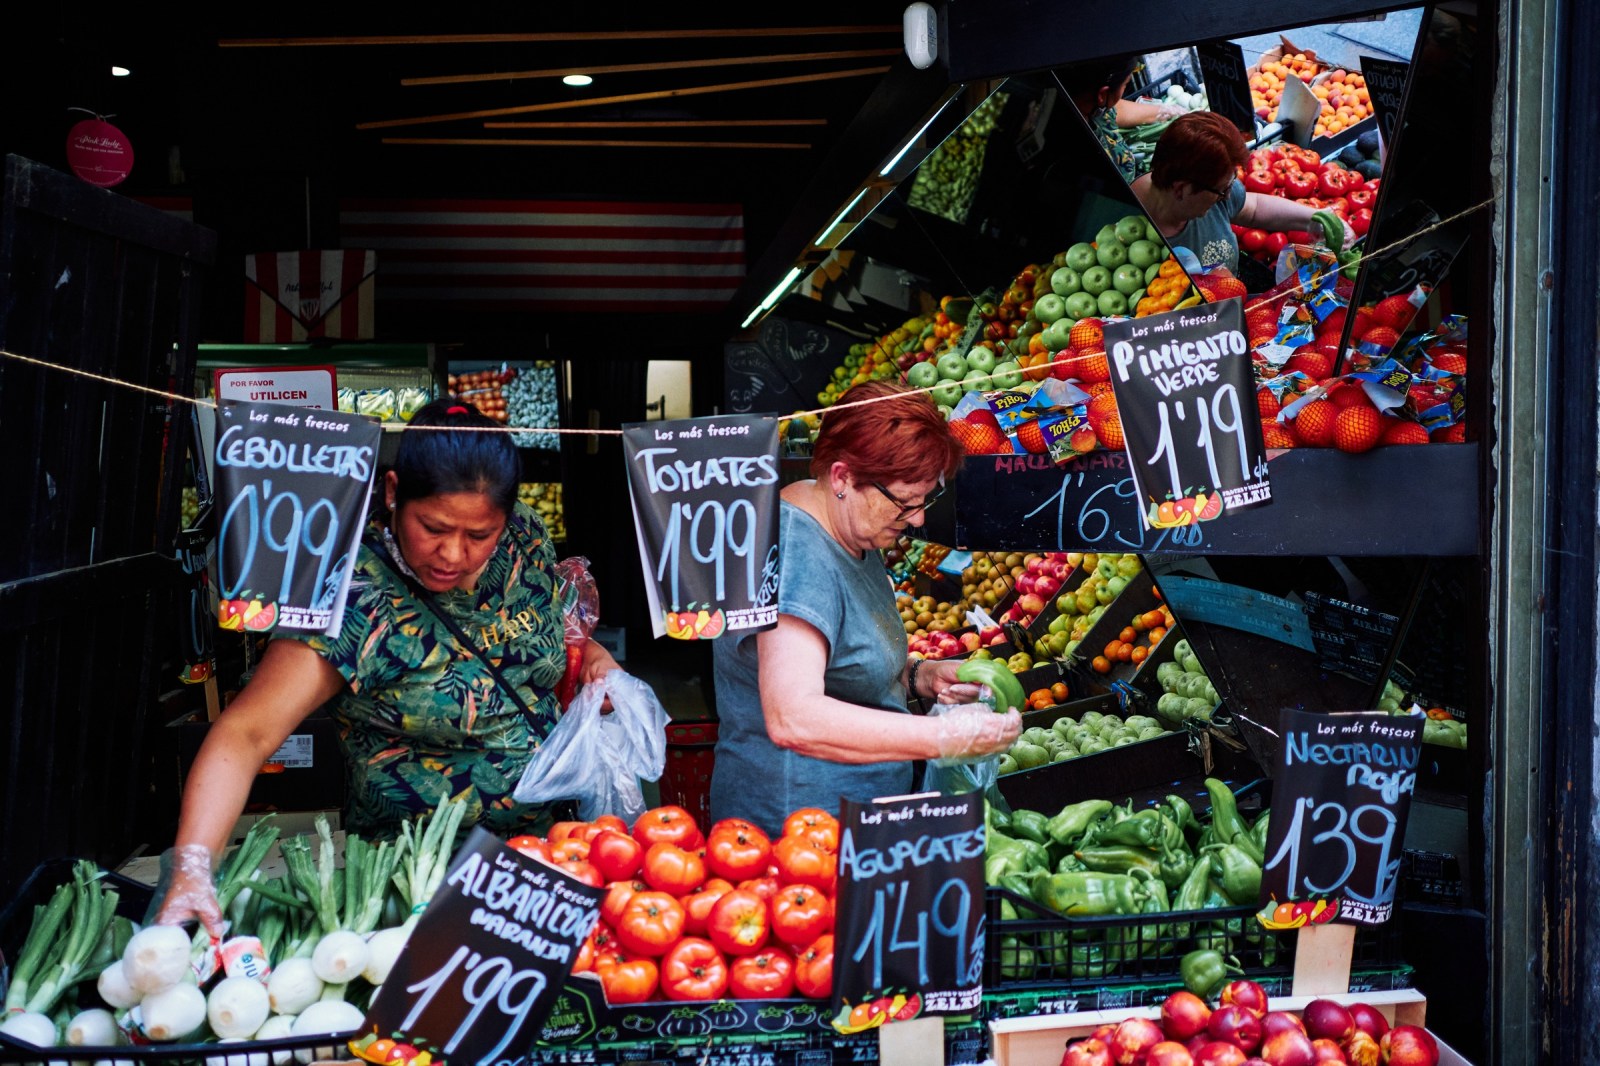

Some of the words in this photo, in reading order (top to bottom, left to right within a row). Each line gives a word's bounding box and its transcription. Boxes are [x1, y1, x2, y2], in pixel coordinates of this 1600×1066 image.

[76, 135, 99, 144] Pink
[99, 137, 123, 151] Lady
[1132, 325, 1149, 338] Los
[1154, 320, 1175, 333] más
[1180, 312, 1218, 328] frescos
[250, 390, 307, 400] UTILICEN
[1151, 362, 1220, 397] VERDE
[250, 410, 269, 423] Los
[274, 412, 299, 426] más
[305, 415, 350, 433] frescos
[655, 428, 673, 440] Los
[680, 426, 702, 438] más
[707, 423, 749, 437] frescos
[1147, 383, 1250, 500] 1'19
[216, 425, 373, 482] CEBOLLETAS
[634, 447, 779, 494] TOMATES
[218, 479, 339, 606] 0'99
[657, 498, 757, 611] 1'99
[1317, 722, 1336, 736] Los
[1341, 720, 1363, 734] más
[1370, 721, 1417, 740] frescos
[860, 811, 882, 825] Los
[888, 807, 914, 821] más
[921, 803, 968, 818] frescos
[839, 825, 986, 882] AGUACATES
[1265, 796, 1397, 905] 1'39
[496, 852, 516, 872] Los
[521, 867, 550, 890] más
[553, 878, 598, 907] frescos
[852, 877, 972, 989] 1'49
[400, 945, 548, 1066] 1'99
[541, 1023, 582, 1040] Finest
